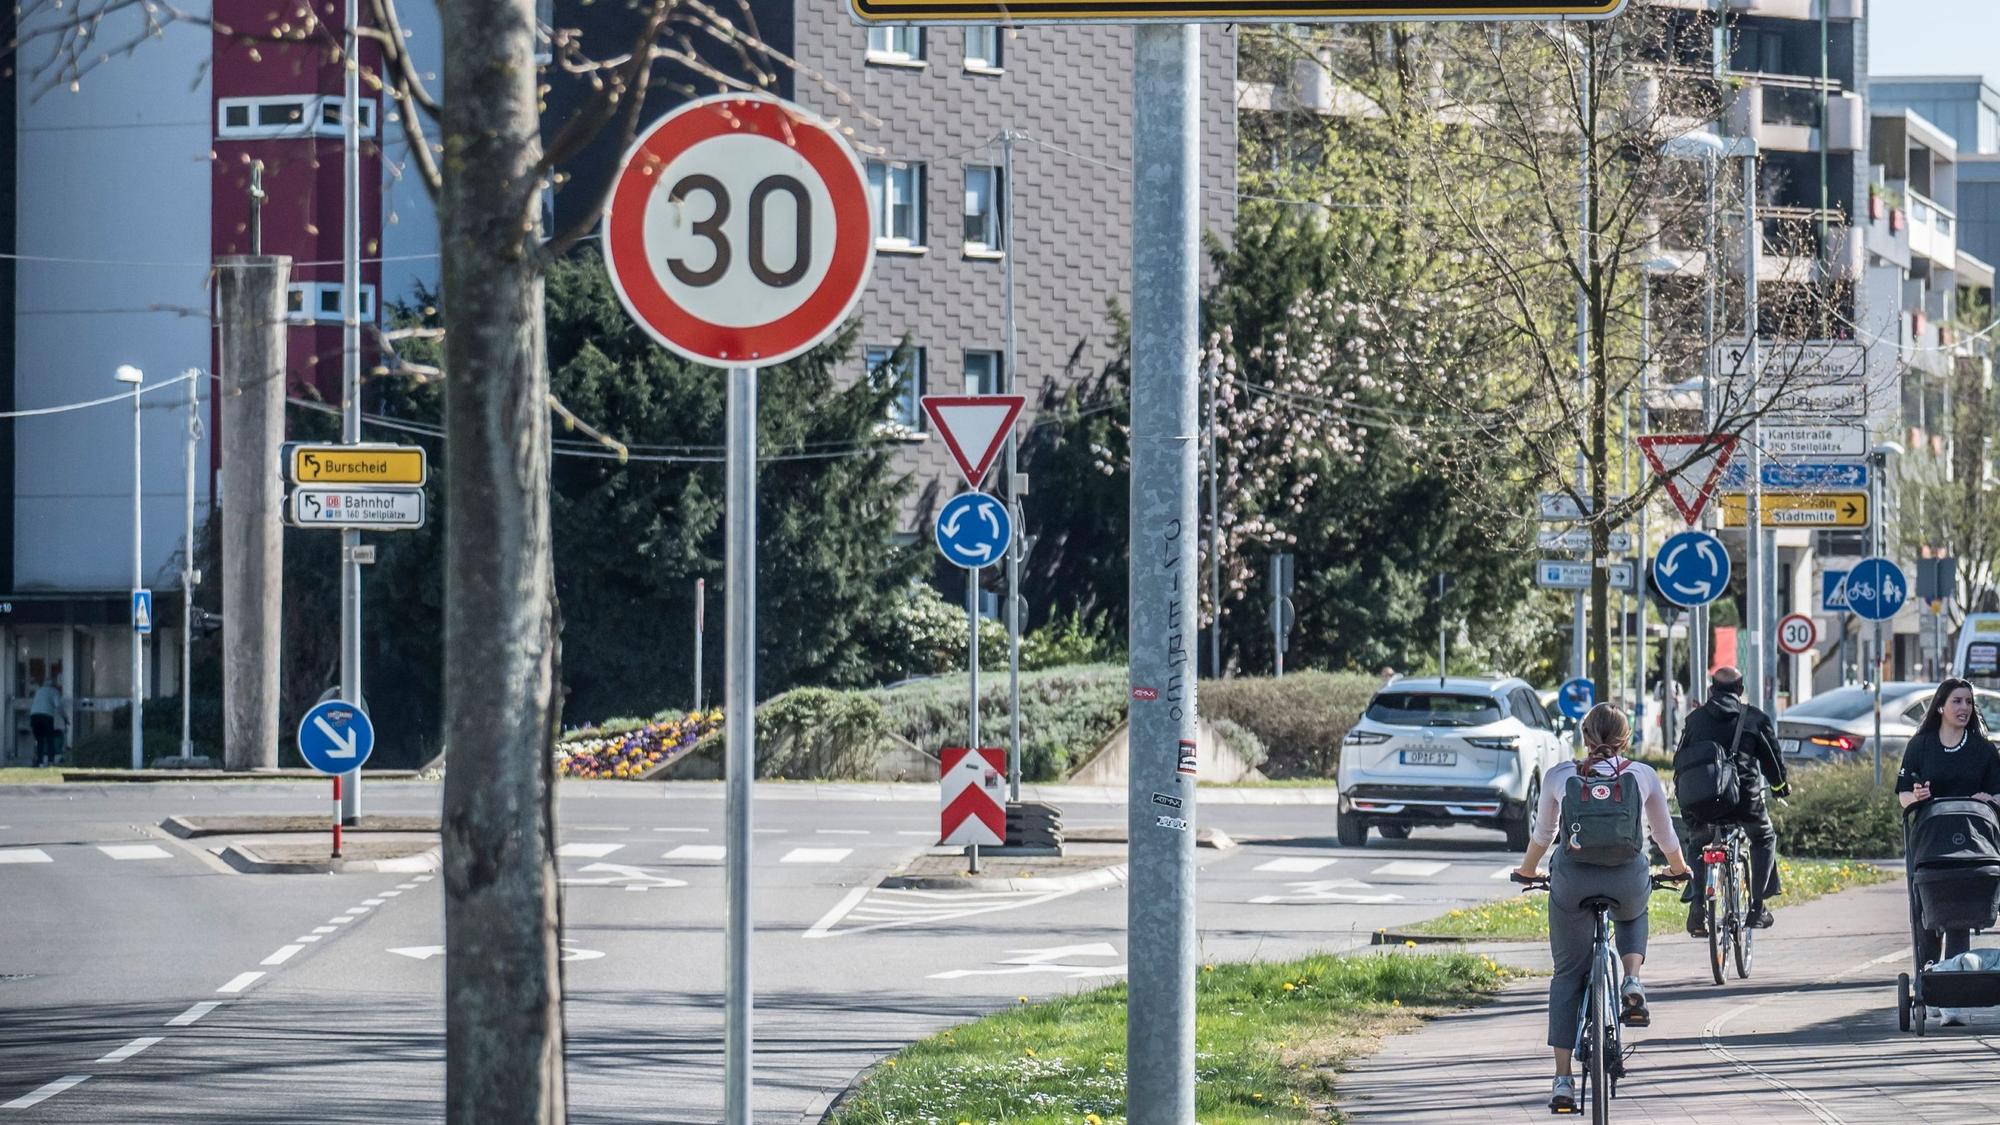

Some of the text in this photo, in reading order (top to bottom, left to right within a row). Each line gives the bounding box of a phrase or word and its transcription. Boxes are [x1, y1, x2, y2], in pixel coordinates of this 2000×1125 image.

[667, 174, 811, 288] 30
[325, 460, 387, 473] Burscheid
[345, 496, 395, 508] Bahnhof
[347, 510, 360, 519] 160
[1774, 511, 1835, 521] Stadtmitte
[1787, 624, 1808, 643] 30
